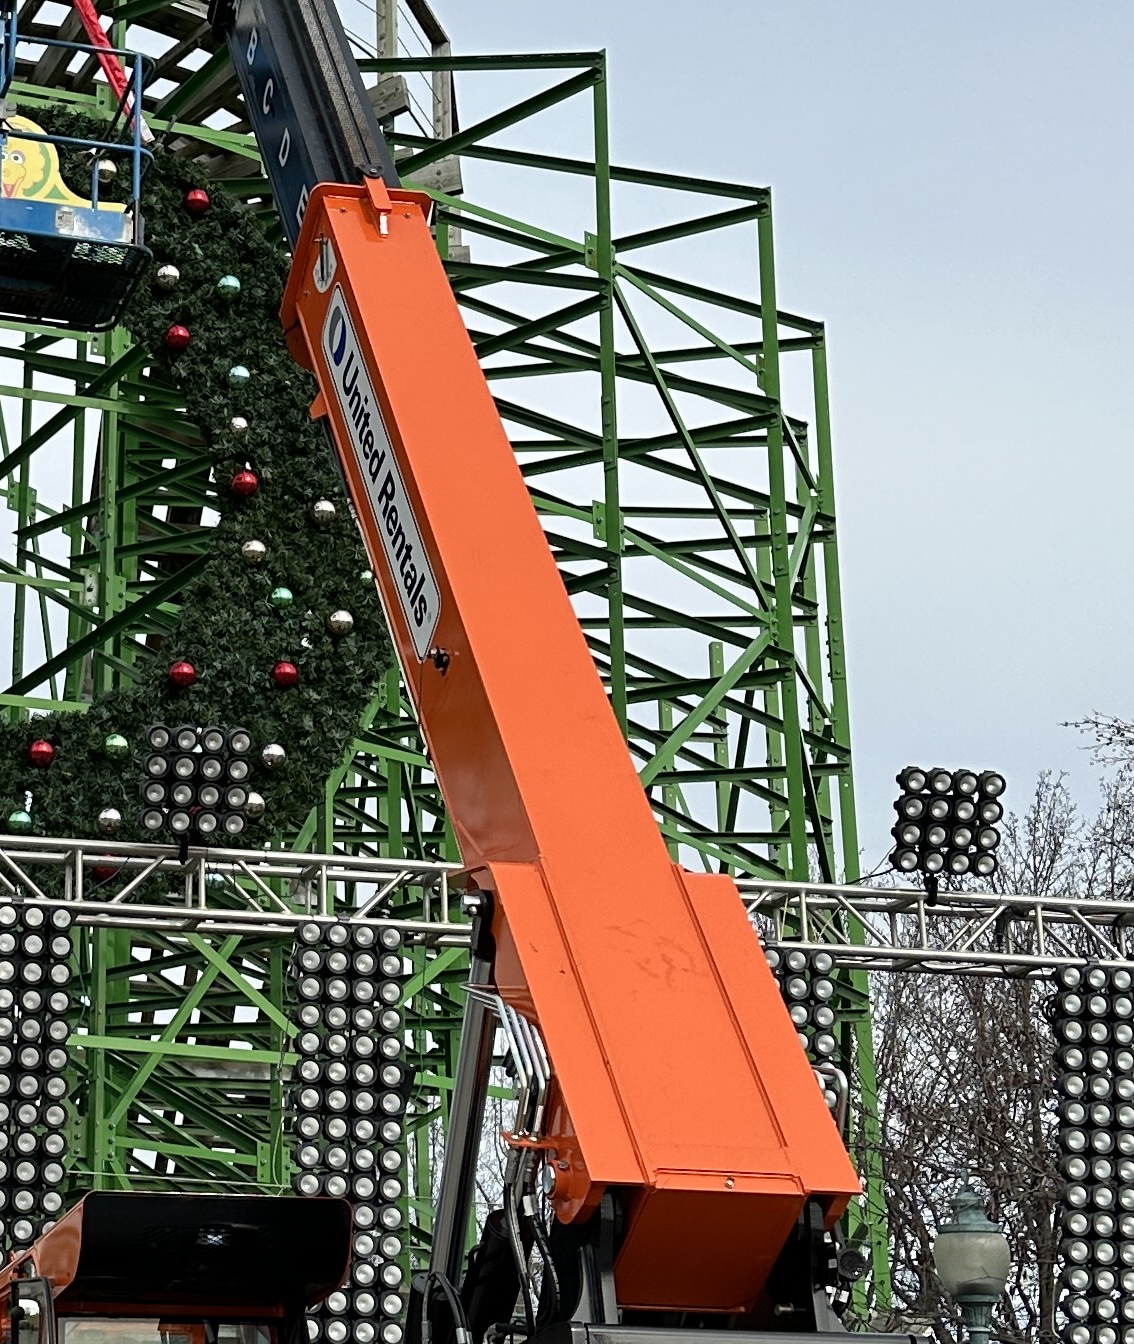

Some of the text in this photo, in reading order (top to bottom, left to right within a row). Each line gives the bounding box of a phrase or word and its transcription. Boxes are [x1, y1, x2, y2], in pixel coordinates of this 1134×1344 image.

[247, 26, 258, 66] B
[263, 77, 274, 115] C
[278, 127, 291, 168] D
[341, 350, 428, 628] United Rentals
